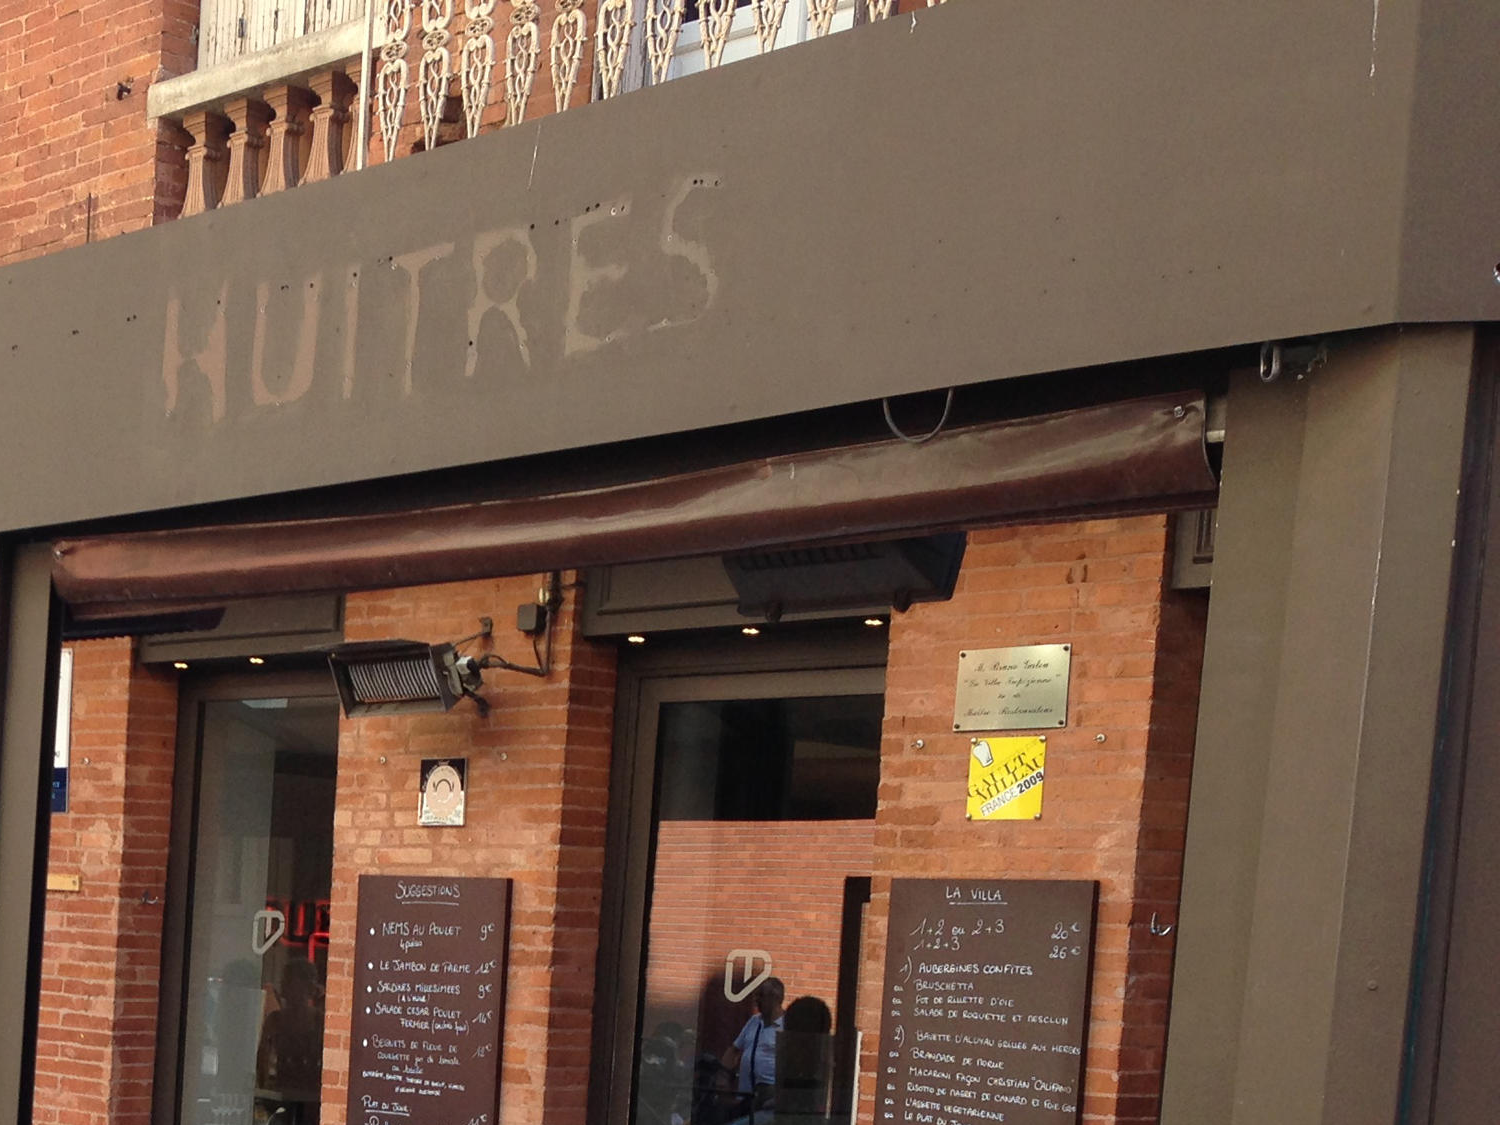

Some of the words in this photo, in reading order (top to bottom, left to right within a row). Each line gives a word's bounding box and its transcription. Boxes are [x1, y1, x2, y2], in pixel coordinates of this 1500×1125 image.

[161, 171, 724, 423] HUITRES
[981, 787, 1019, 817] FRANCE
[1017, 770, 1044, 794] 2009
[395, 881, 460, 899] SUGGESTIONS
[946, 886, 961, 899] LA
[971, 888, 1002, 901] VILLA
[382, 922, 410, 936] NEMS
[413, 925, 424, 936] AU
[428, 922, 462, 936] POULET
[380, 960, 390, 971] LE
[392, 960, 427, 972] JAMBON
[430, 963, 440, 973] DE
[442, 961, 471, 974] PARME
[918, 964, 980, 974] AUBERGINES
[983, 964, 1033, 976] CONFITES
[913, 978, 974, 991] BRUSCHETTA
[933, 996, 944, 1005] DE
[375, 1002, 402, 1015] SALADE
[433, 1006, 461, 1019] POULET
[913, 1008, 944, 1018] SALADE
[947, 1009, 959, 1019] DE
[962, 1011, 1007, 1023] ROQUETTE
[1012, 1013, 1023, 1023] ET
[1027, 1013, 1069, 1025] MESCLUN
[916, 1030, 951, 1042] BAVETTE
[1031, 1043, 1047, 1052] AUX
[910, 1047, 956, 1063] BRANDADE
[962, 1057, 973, 1067] DE
[909, 1066, 951, 1080] MACARONI
[987, 1076, 1030, 1089] CHRISTIAN
[907, 1082, 935, 1094] RISOTTO
[936, 1086, 947, 1097] DE
[981, 1092, 992, 1102] DE
[994, 1094, 1028, 1106] CANARD
[916, 1114, 934, 1125] PLAT
